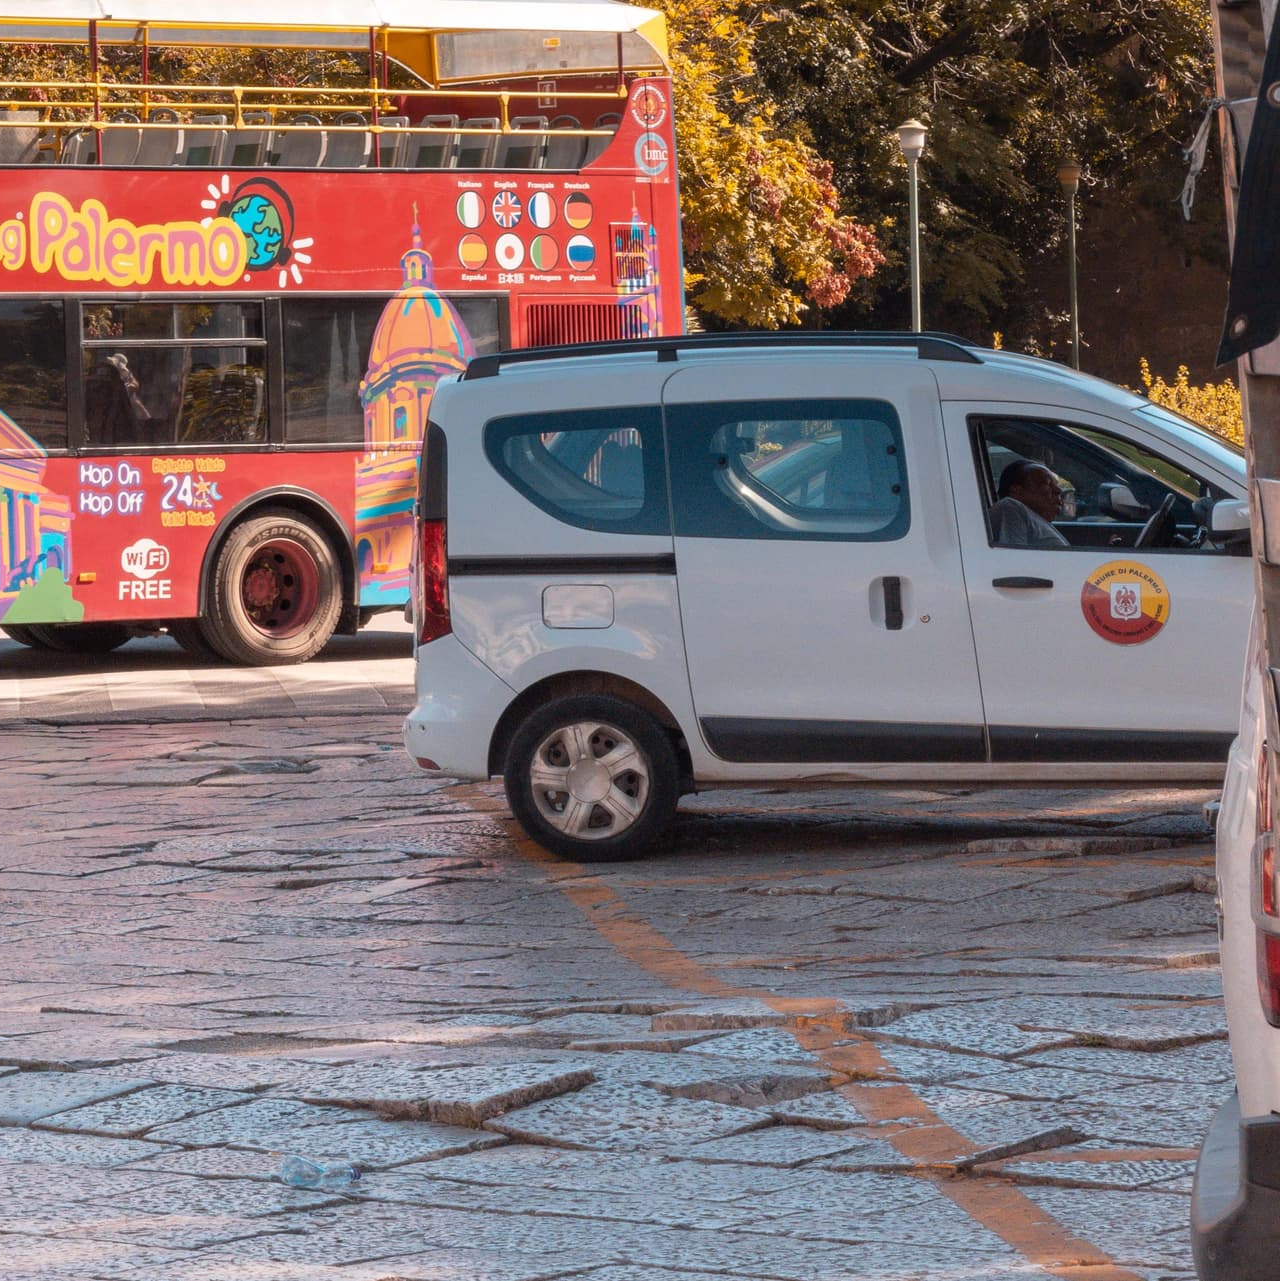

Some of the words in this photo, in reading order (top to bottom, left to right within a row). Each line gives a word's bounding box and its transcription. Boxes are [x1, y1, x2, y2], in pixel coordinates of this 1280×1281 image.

[493, 180, 518, 190] English
[30, 191, 248, 287] Palermo
[79, 463, 112, 486] Hop
[117, 463, 140, 484] On
[79, 492, 111, 515] Hop
[117, 491, 143, 512] Off
[161, 474, 193, 510] 24
[119, 580, 171, 600] FREE
[1128, 568, 1162, 594] PALERMO
